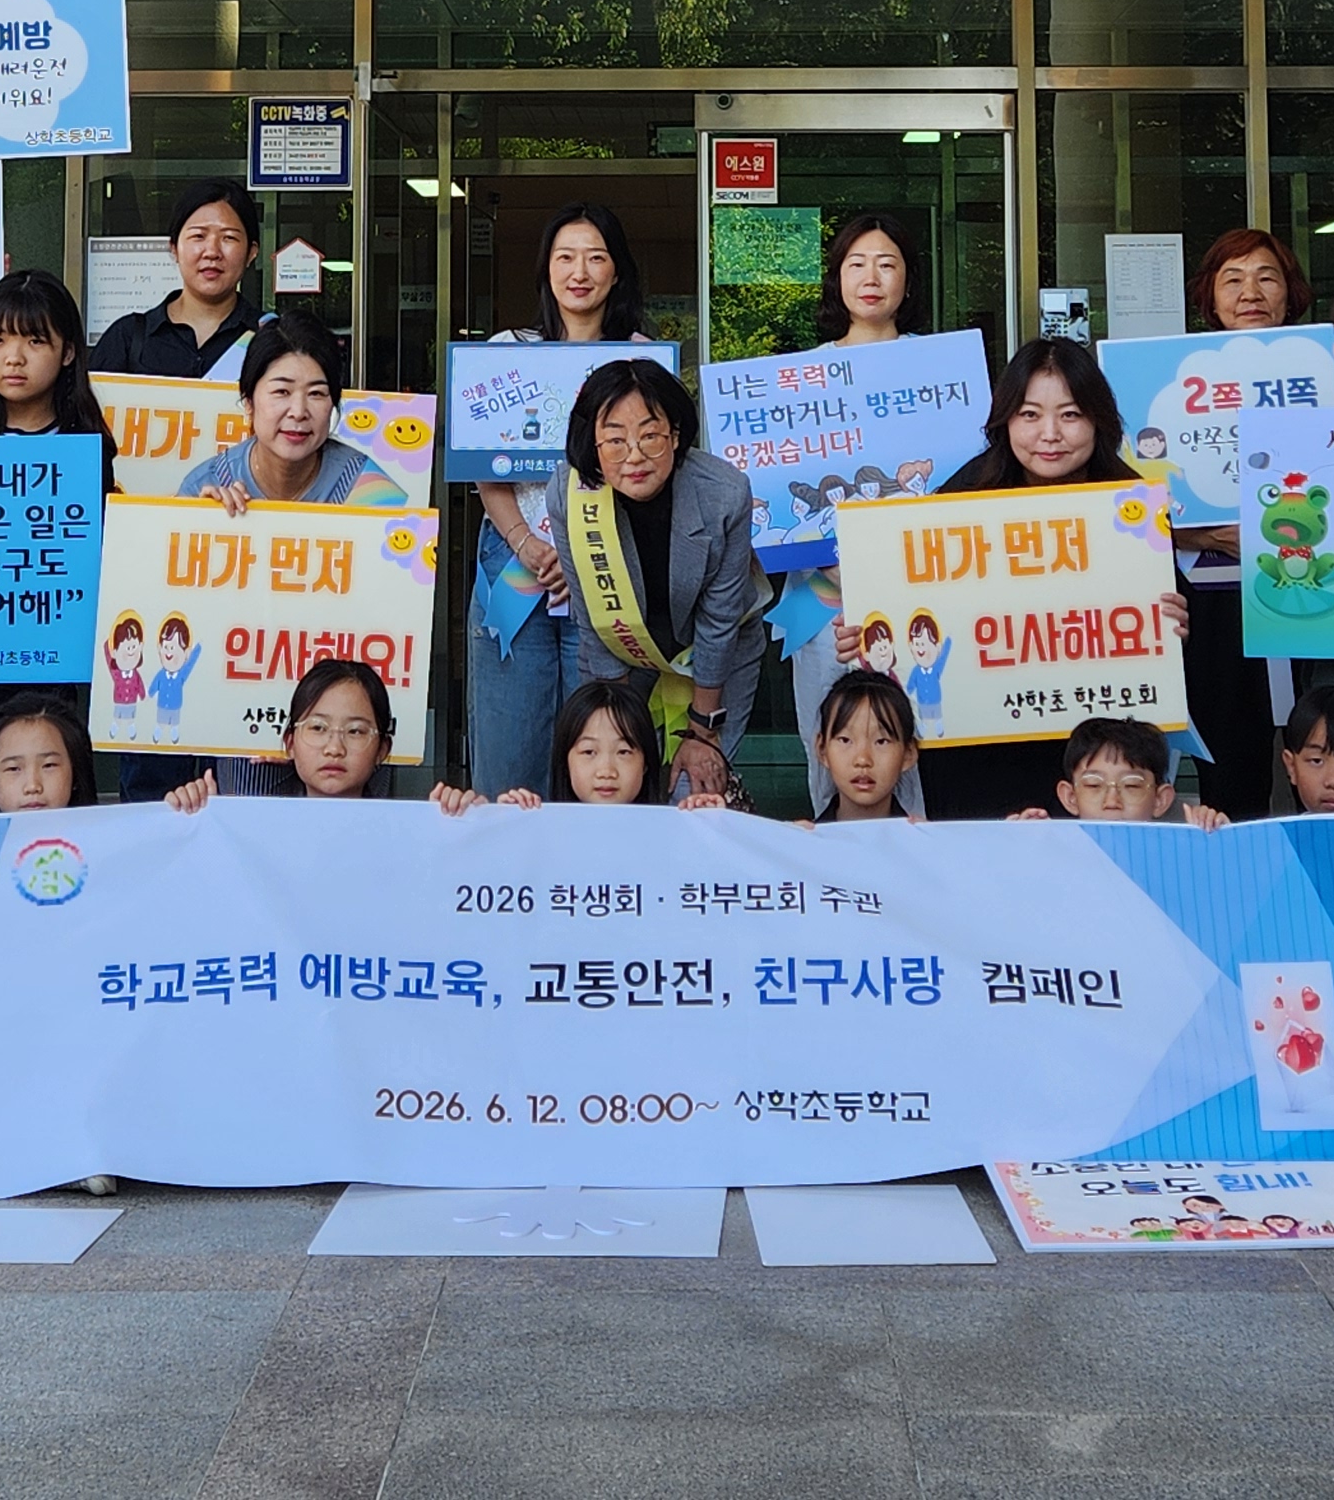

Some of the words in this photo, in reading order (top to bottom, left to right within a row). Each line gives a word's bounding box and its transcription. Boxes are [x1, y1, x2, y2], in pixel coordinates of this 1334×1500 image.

[25, 129, 113, 146] 상학초등학교
[725, 156, 765, 172] 에스원
[715, 191, 749, 200] SECOM
[491, 376, 504, 391] 한
[507, 369, 522, 385] 번
[717, 376, 768, 400] 나는
[776, 360, 855, 392] 폭력에
[1183, 376, 1243, 415] 2쪽
[1252, 376, 1318, 408] 저쪽
[469, 381, 544, 422] 독이되고
[718, 398, 858, 436] 가담하거나,
[866, 380, 970, 419] 방관하지
[513, 459, 564, 472] 상학초등
[724, 426, 863, 470] 않겠습니다!
[25, 503, 91, 541] 일은
[166, 532, 257, 589] 내가
[270, 536, 354, 595] 먼저
[903, 525, 992, 585] 내가
[1003, 517, 1090, 577] 먼저
[974, 603, 1164, 669] 인사해요!
[1003, 689, 1068, 719] 상학초
[1074, 684, 1158, 714] 학부모회
[455, 885, 536, 915] 2026
[548, 885, 644, 918] 학생회
[678, 881, 807, 915] 학부모회
[820, 884, 882, 916] 주관
[97, 952, 278, 1012] 학교폭력
[299, 955, 503, 1011] 예방교육,
[525, 958, 731, 1010] 교통안전,
[753, 954, 945, 1008] 친구사랑
[982, 960, 1122, 1010] 캠페인
[375, 1089, 472, 1121] 2026.
[485, 1093, 514, 1123] 6.
[528, 1095, 566, 1124] 12.
[733, 1089, 931, 1125] 상학초등학교
[1081, 1178, 1205, 1197] 오늘도
[1213, 1171, 1313, 1193] 힘내!
